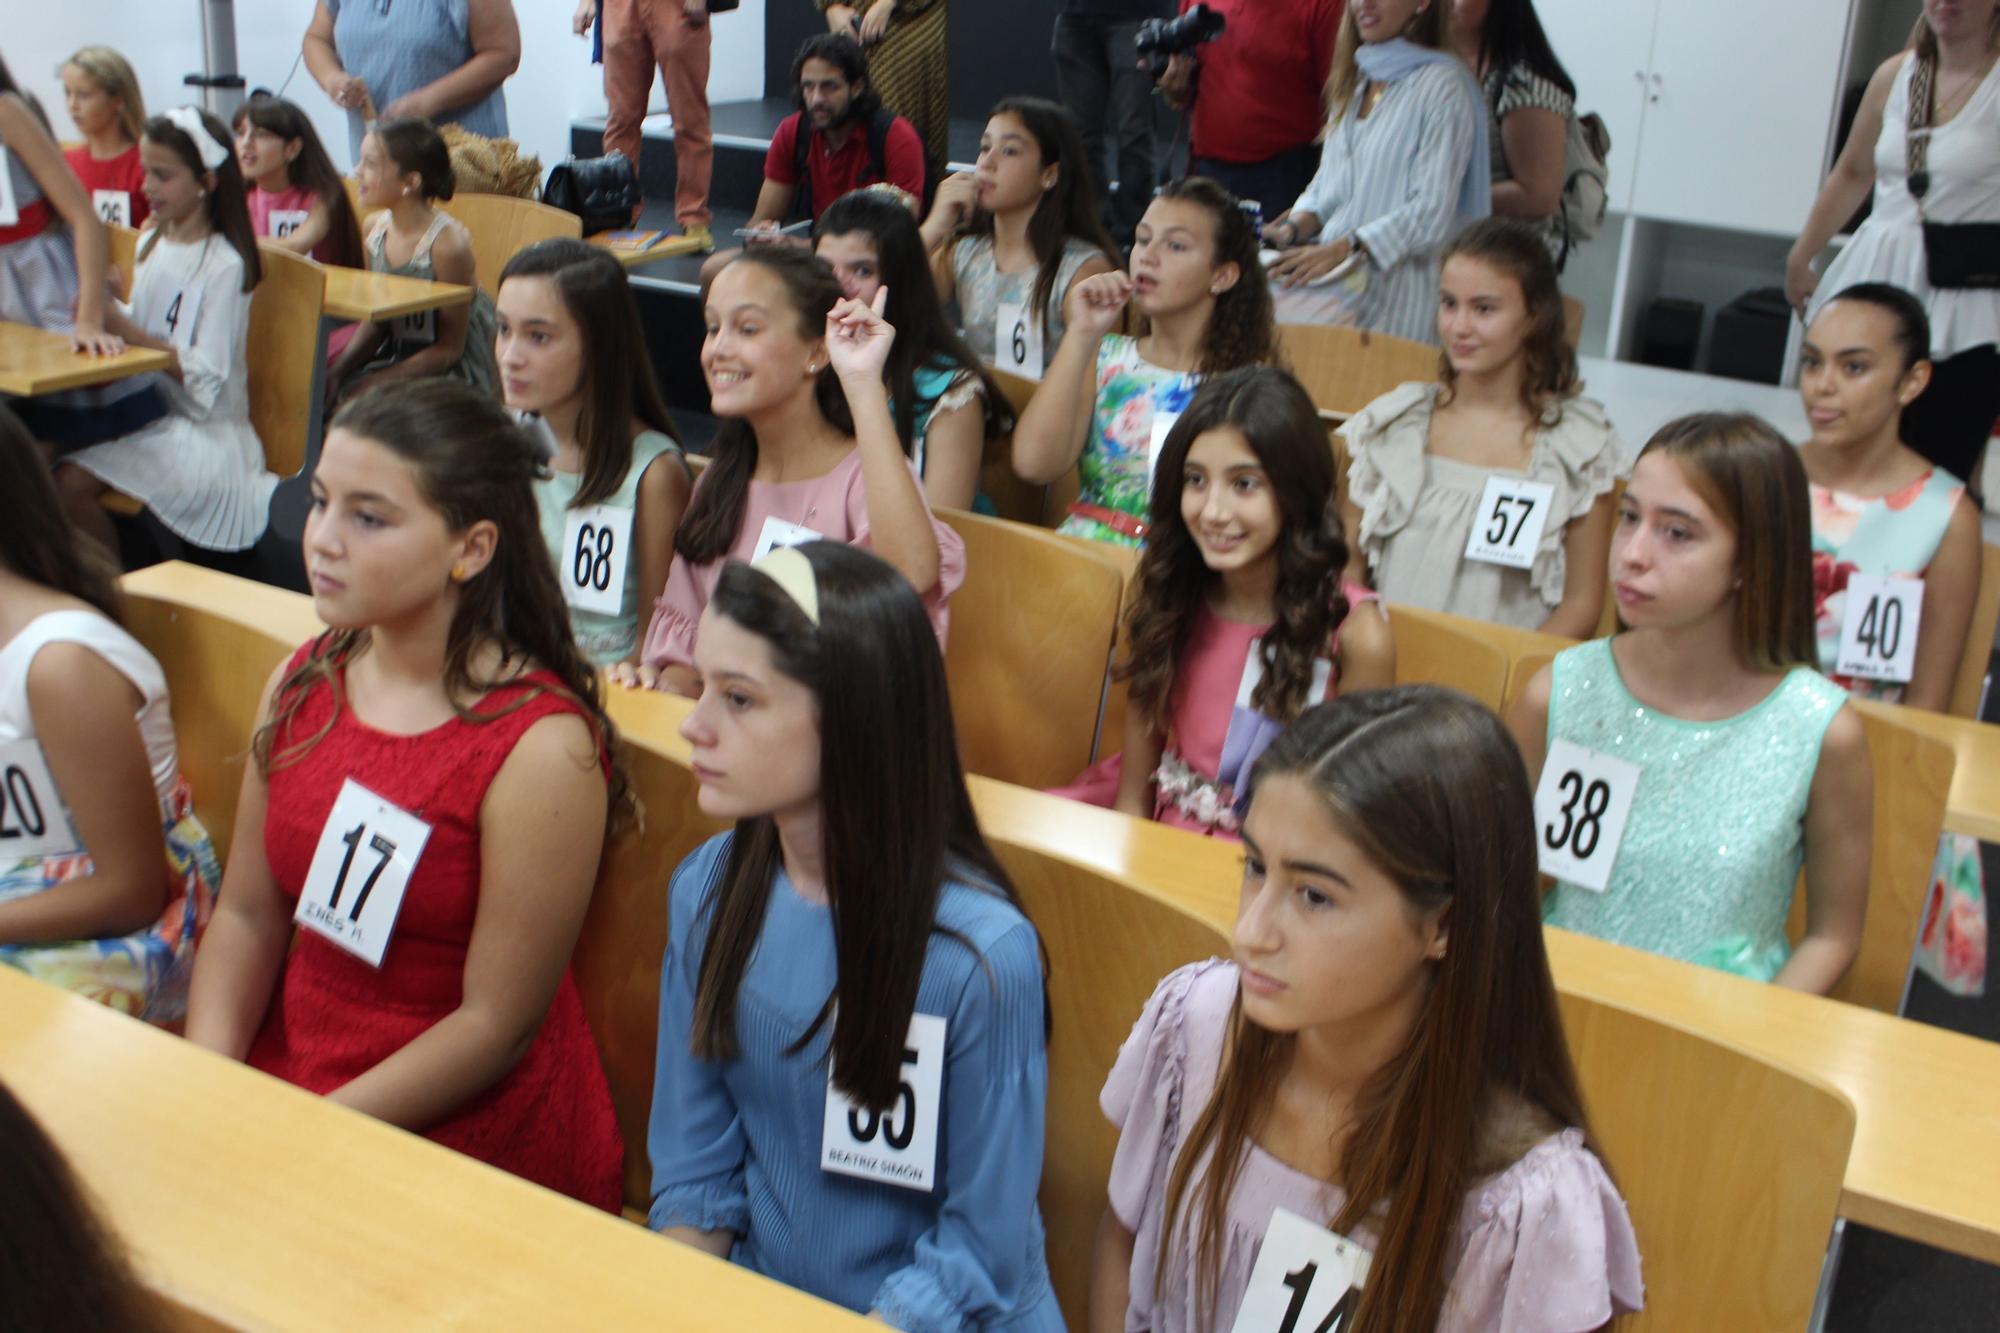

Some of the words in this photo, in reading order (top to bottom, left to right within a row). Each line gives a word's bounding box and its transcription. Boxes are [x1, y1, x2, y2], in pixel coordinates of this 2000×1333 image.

[166, 292, 183, 333] 4
[1012, 320, 1026, 364] 6
[1486, 495, 1535, 547] 57
[574, 523, 613, 592] 68
[1856, 594, 1903, 660] 40
[1545, 769, 1611, 860] 38
[328, 821, 398, 923] 17
[829, 1147, 879, 1170] BEATRIZ
[881, 1158, 923, 1183] SIMÓN
